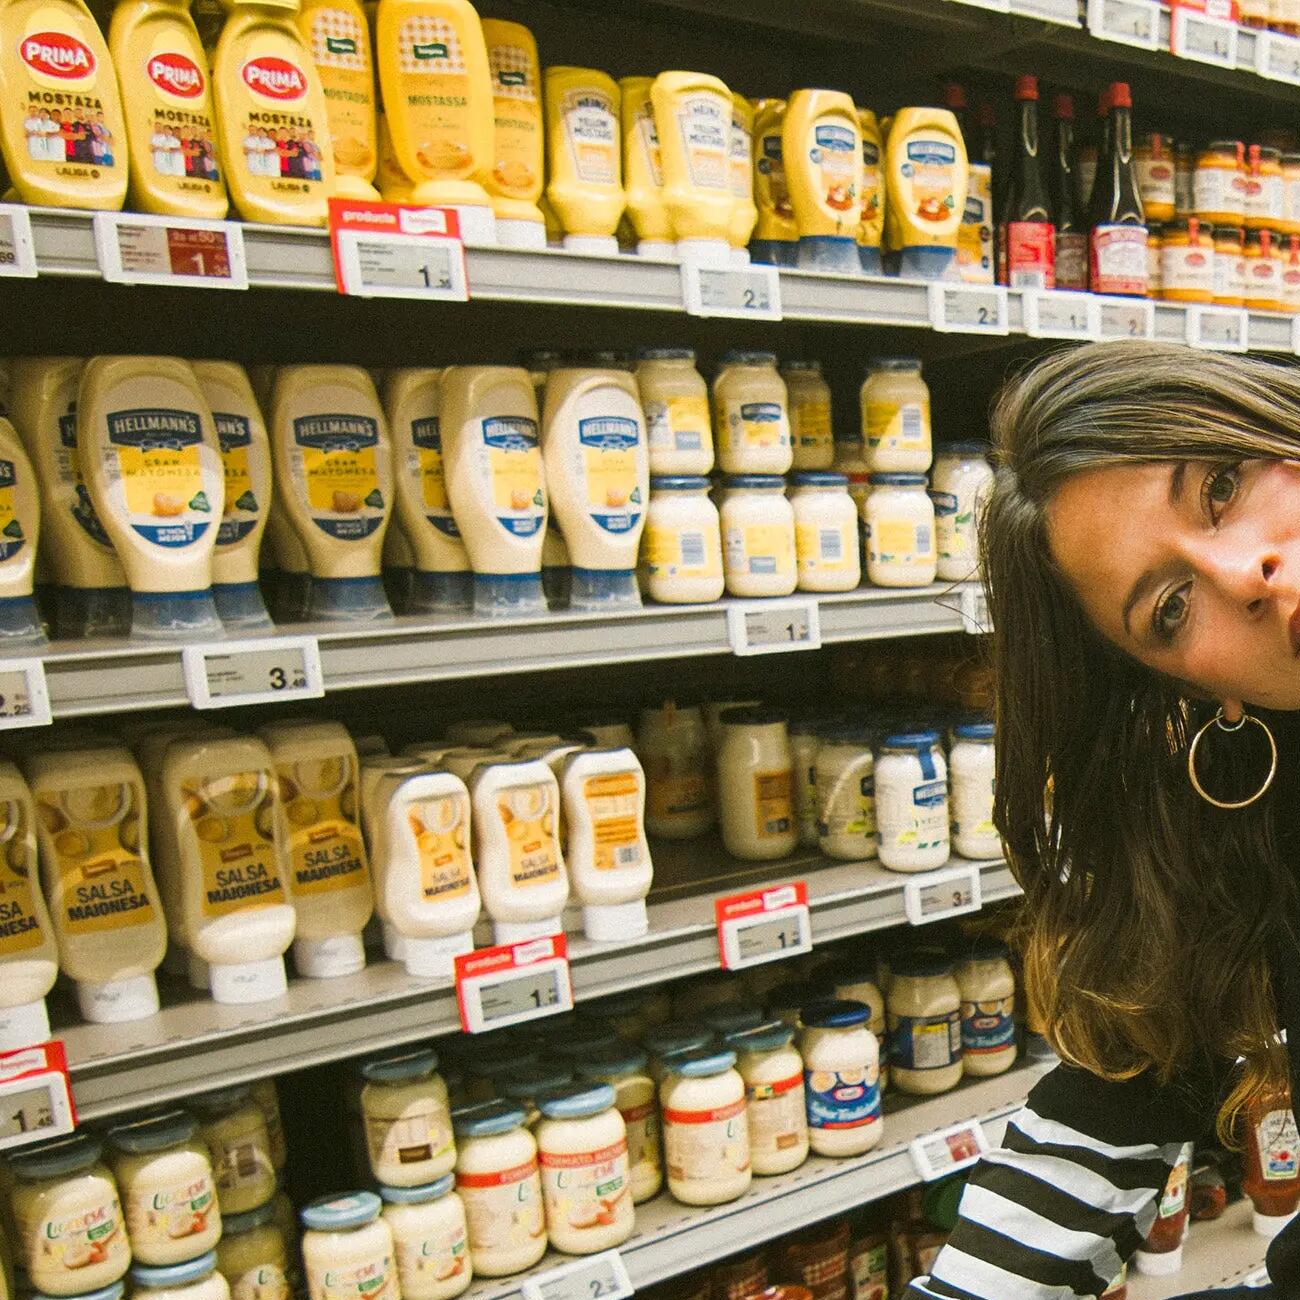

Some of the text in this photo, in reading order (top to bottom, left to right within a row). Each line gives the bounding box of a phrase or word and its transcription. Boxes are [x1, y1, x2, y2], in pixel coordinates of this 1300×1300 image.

[26, 41, 90, 71] PRIMA
[151, 60, 201, 90] PRIMA
[248, 65, 304, 95] PRIMA
[28, 90, 102, 109] MOSTAZA
[408, 95, 467, 108] MOSTASSA
[154, 109, 211, 127] MOSTAZA
[249, 112, 313, 129] MOSTAZA
[114, 415, 197, 434] HELLMANN'S
[300, 421, 375, 437] HELLMANN'S
[303, 844, 350, 868] SALSA
[215, 862, 268, 888] SALSA
[76, 879, 135, 904] SALSA
[207, 877, 281, 904] MAIONESA
[67, 893, 150, 921] MAIONESA
[0, 915, 40, 938] NESA
